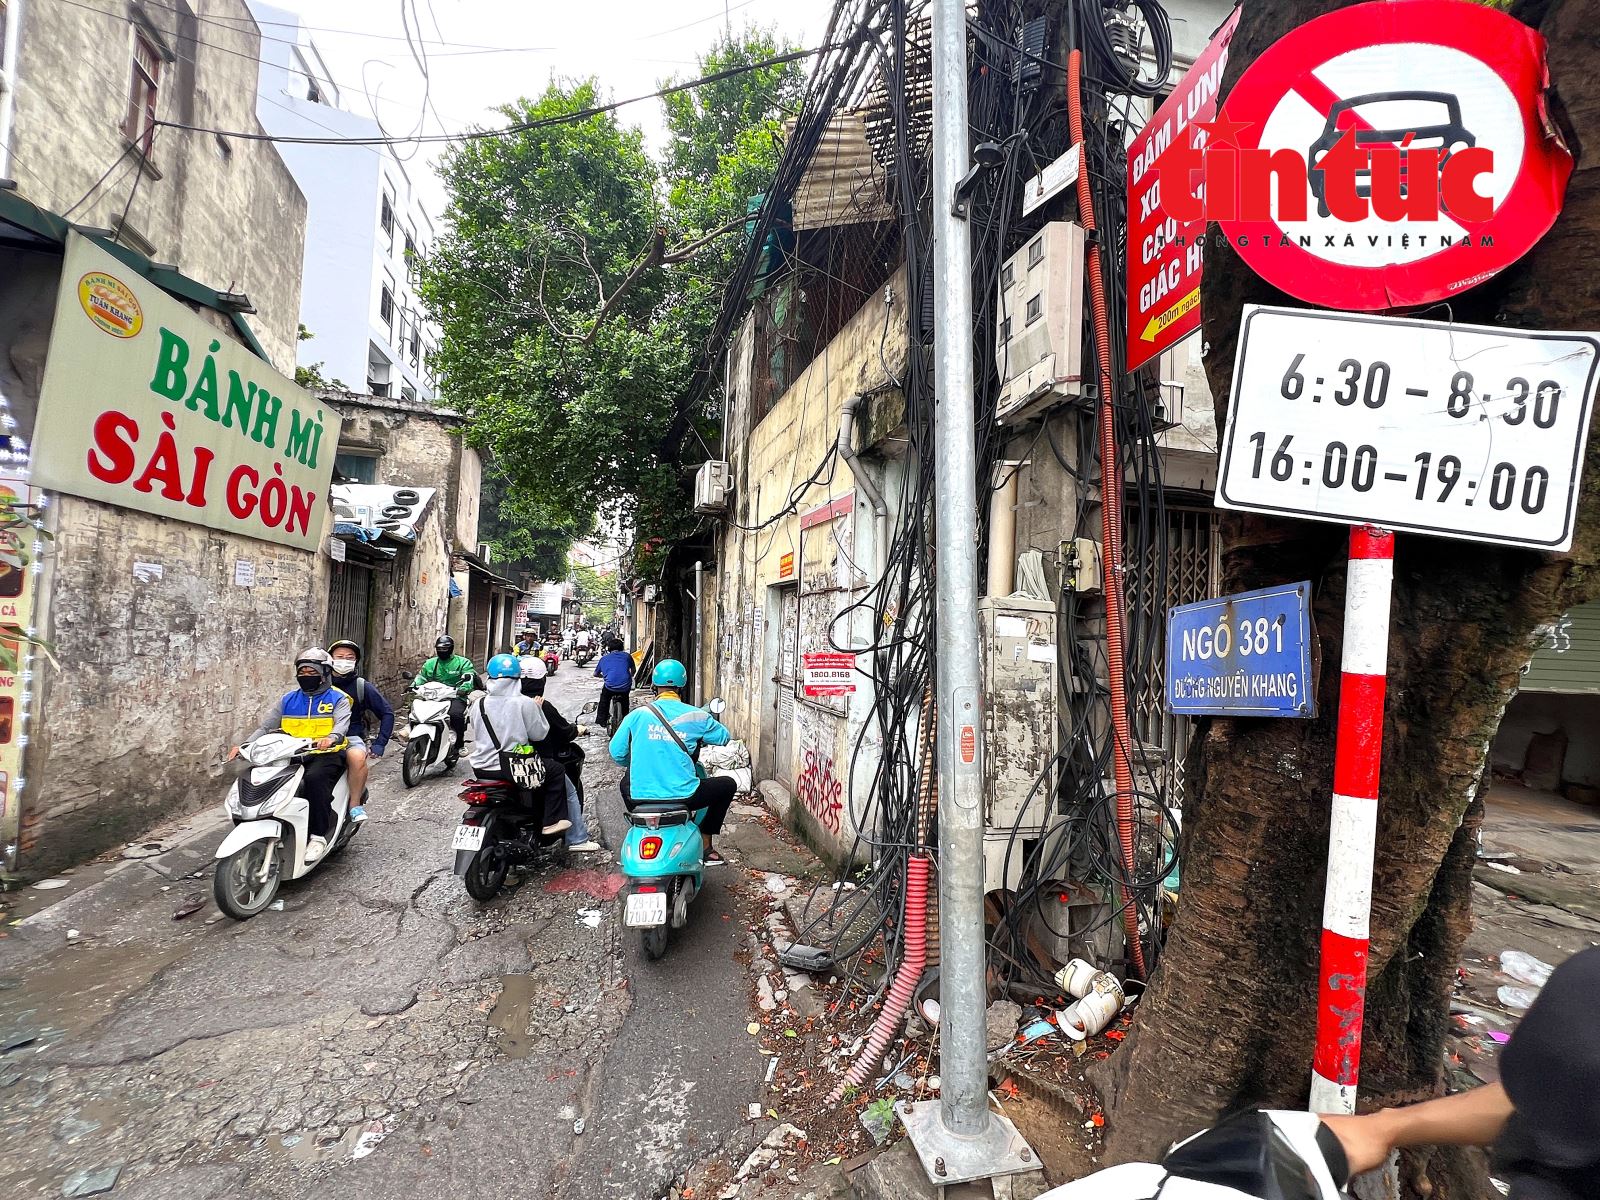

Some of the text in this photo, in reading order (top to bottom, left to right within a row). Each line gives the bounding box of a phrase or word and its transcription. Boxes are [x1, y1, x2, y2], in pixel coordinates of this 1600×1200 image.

[1140, 258, 1180, 313] GIÁC
[1158, 307, 1179, 329] 200m
[150, 326, 323, 470] BÁNH MÌ
[1280, 353, 1391, 409] 6:30
[1447, 370, 1561, 429] 8:30
[87, 410, 316, 538] SÀI GÒN
[1183, 615, 1283, 661] NGÕ 381
[317, 700, 334, 714] be
[1251, 673, 1297, 698] KHANG
